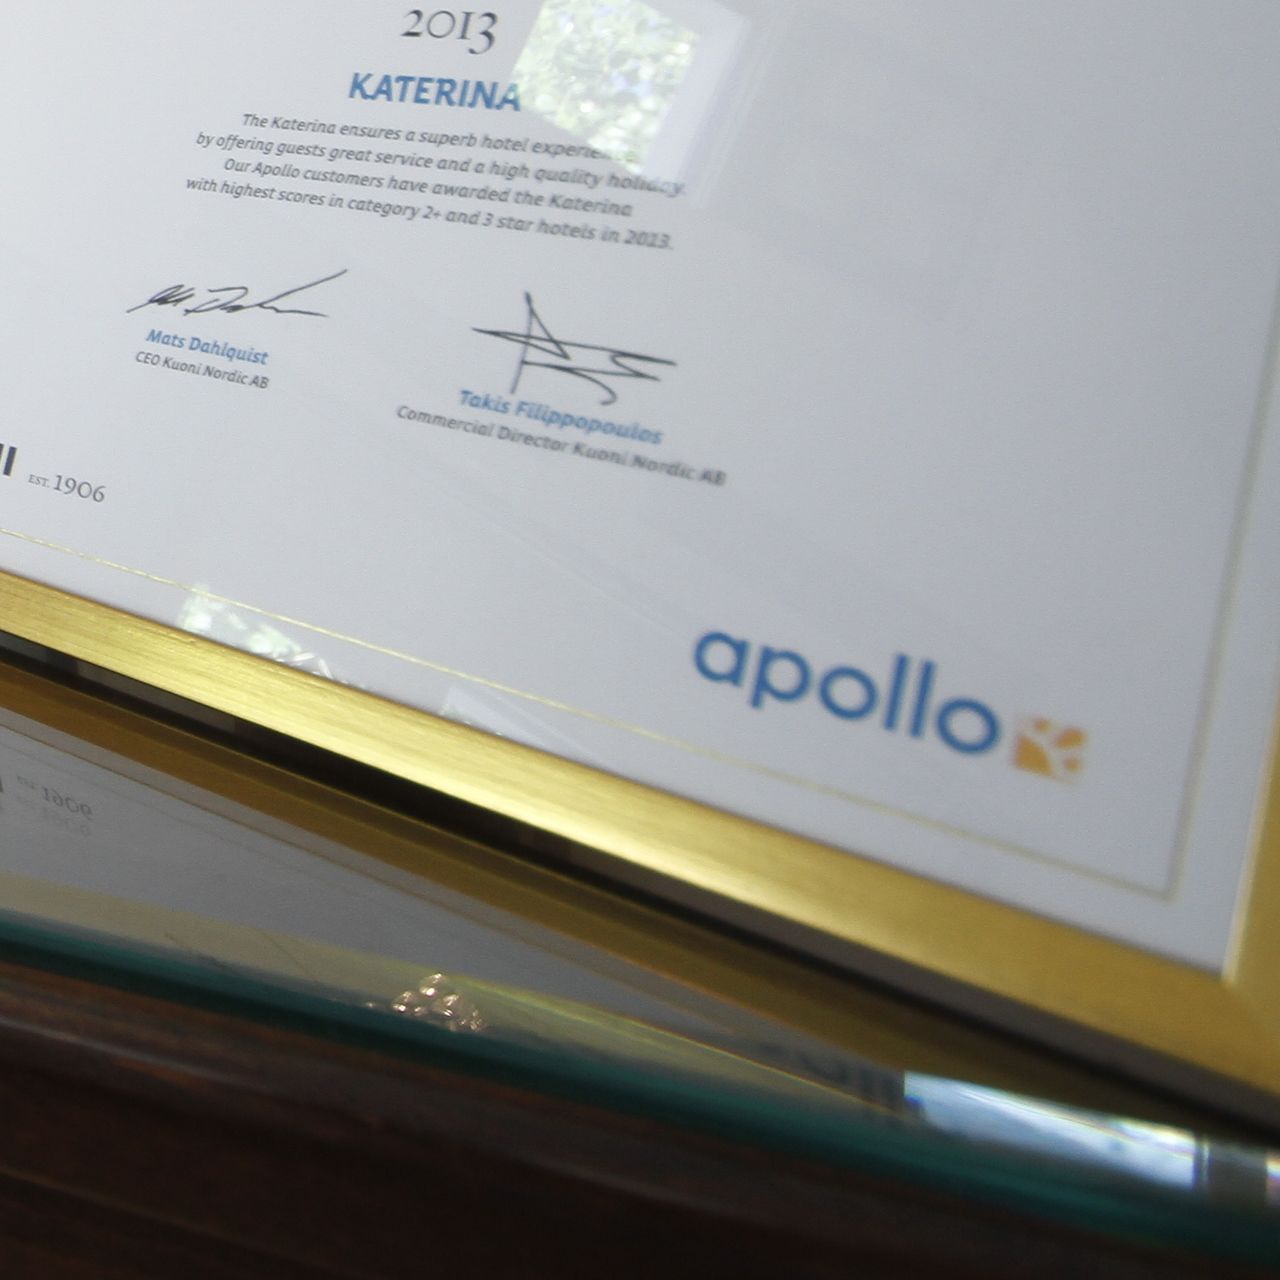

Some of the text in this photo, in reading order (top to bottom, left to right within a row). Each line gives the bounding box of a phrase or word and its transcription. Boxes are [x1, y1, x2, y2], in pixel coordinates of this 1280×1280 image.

[400, 8, 499, 54] 2013
[348, 73, 522, 113] KATERINA
[243, 113, 269, 128] The
[270, 116, 335, 135] Katerina
[340, 122, 402, 141] ensures
[405, 129, 415, 142] a
[419, 130, 477, 151] superb
[480, 135, 529, 153] hotel
[196, 132, 214, 147] by
[216, 134, 274, 155] offering
[277, 140, 326, 157] guests
[327, 147, 372, 162] great
[375, 152, 433, 168] service
[436, 157, 472, 172] and
[474, 161, 486, 174] a
[490, 161, 530, 180] high
[535, 167, 602, 190] quality
[224, 157, 633, 217] Our Apollo customers have awarded the Katerina
[186, 176, 674, 251] with highest scores in category 2+ and 3 star hotels in 2013.
[135, 351, 270, 389] CEO Kuoni Nordic AB
[146, 329, 269, 365] Mats Dahlquist
[460, 389, 665, 445] Takis Filippopoulos
[396, 405, 727, 487] Commercial Director Kuoni Nordic AB
[28, 474, 51, 489] EST.
[53, 474, 107, 502] 1906
[693, 631, 1002, 757] apollo
